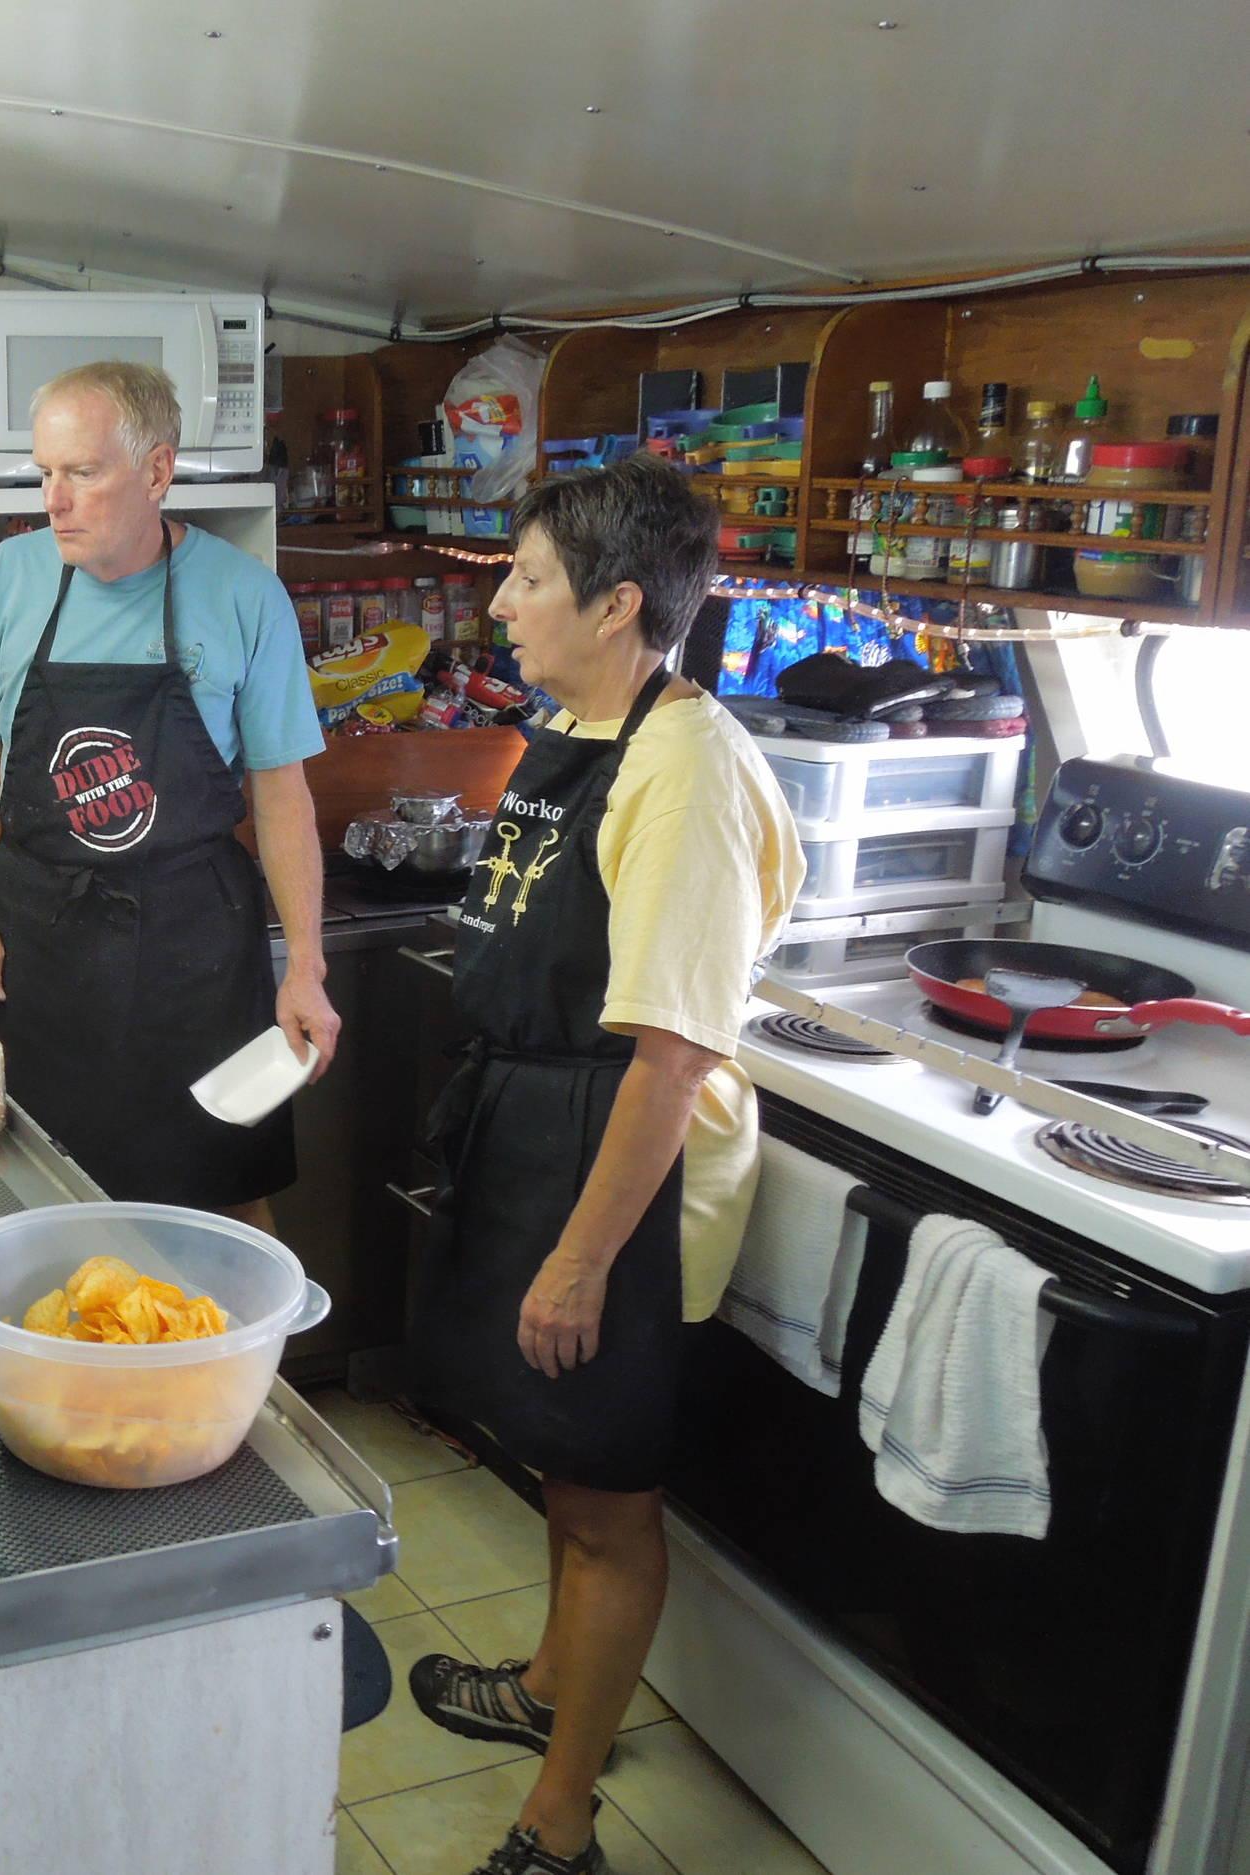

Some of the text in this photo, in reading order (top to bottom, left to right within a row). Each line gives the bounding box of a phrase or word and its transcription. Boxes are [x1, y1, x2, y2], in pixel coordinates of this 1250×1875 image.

[335, 668, 386, 692] Classic
[51, 742, 142, 801] DUDE
[74, 773, 133, 805] WITH THE
[502, 789, 565, 822] Worko
[66, 780, 155, 834] FOOD
